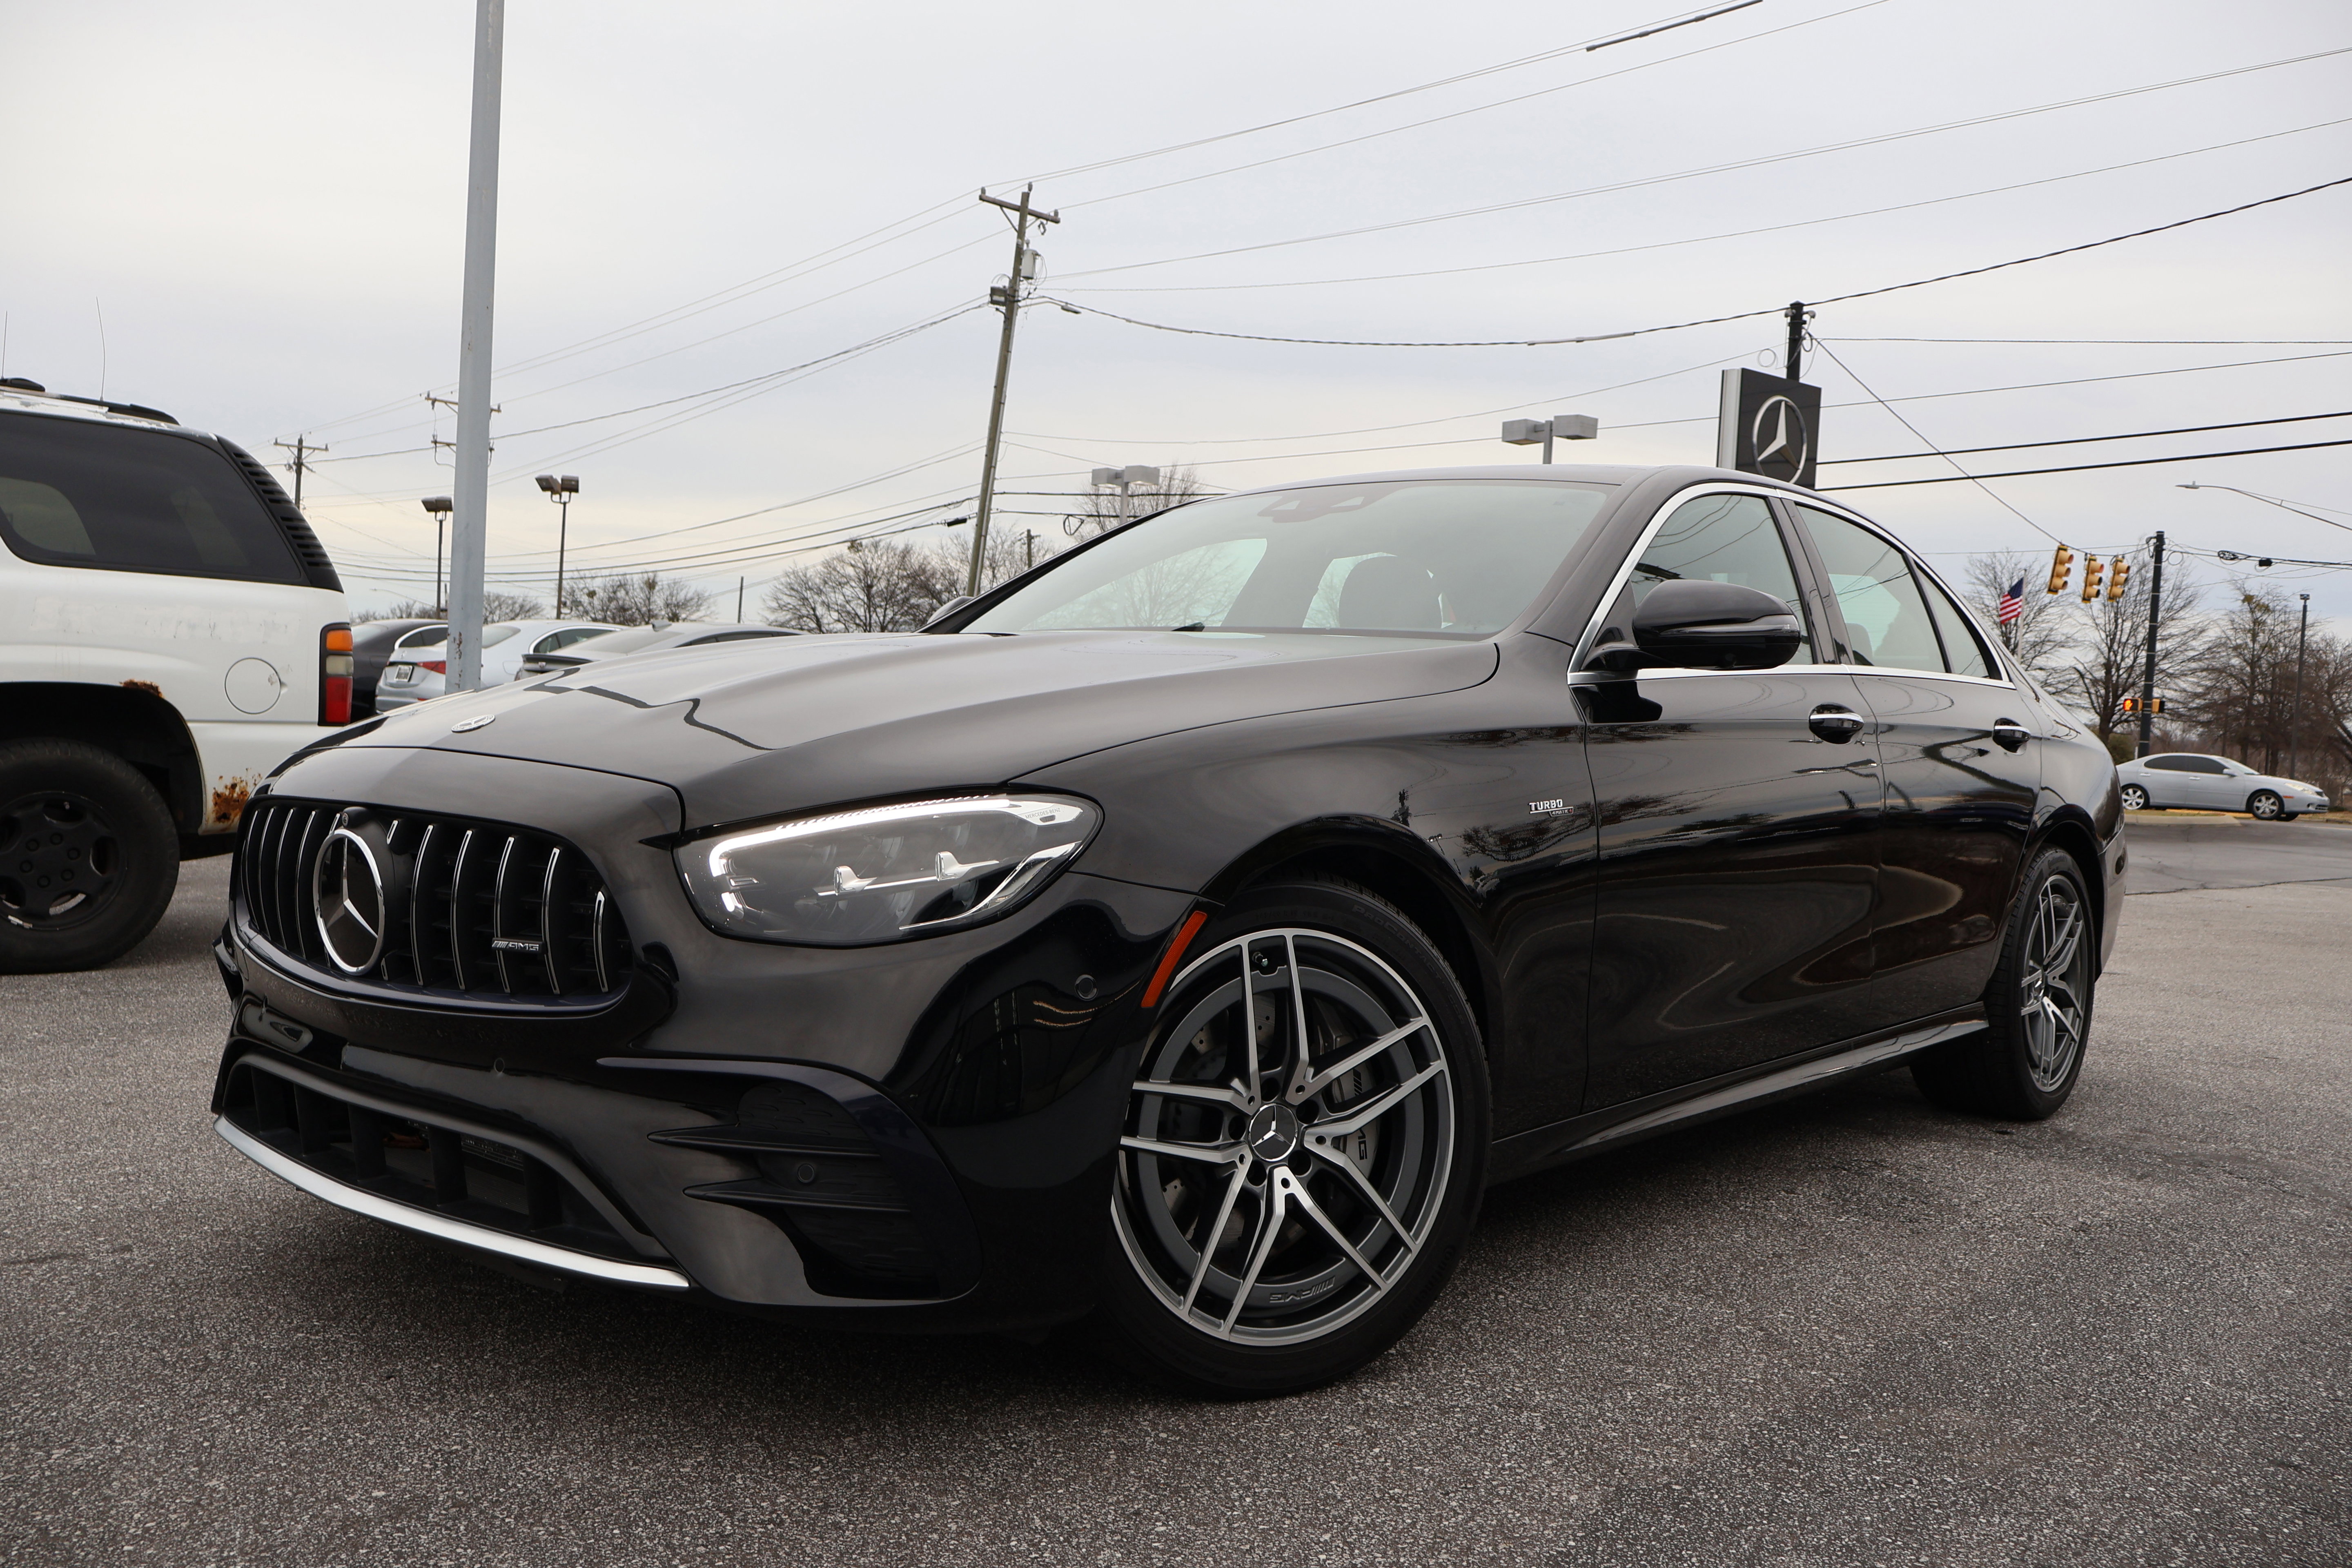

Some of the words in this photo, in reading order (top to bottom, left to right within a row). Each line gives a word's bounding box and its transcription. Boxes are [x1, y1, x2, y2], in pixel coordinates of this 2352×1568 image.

[1529, 799, 1563, 811] TURBO
[1025, 808, 1061, 819] MERCEDES-BENZ
[507, 942, 539, 951] AMG
[1269, 1286, 1314, 1303] AMG
